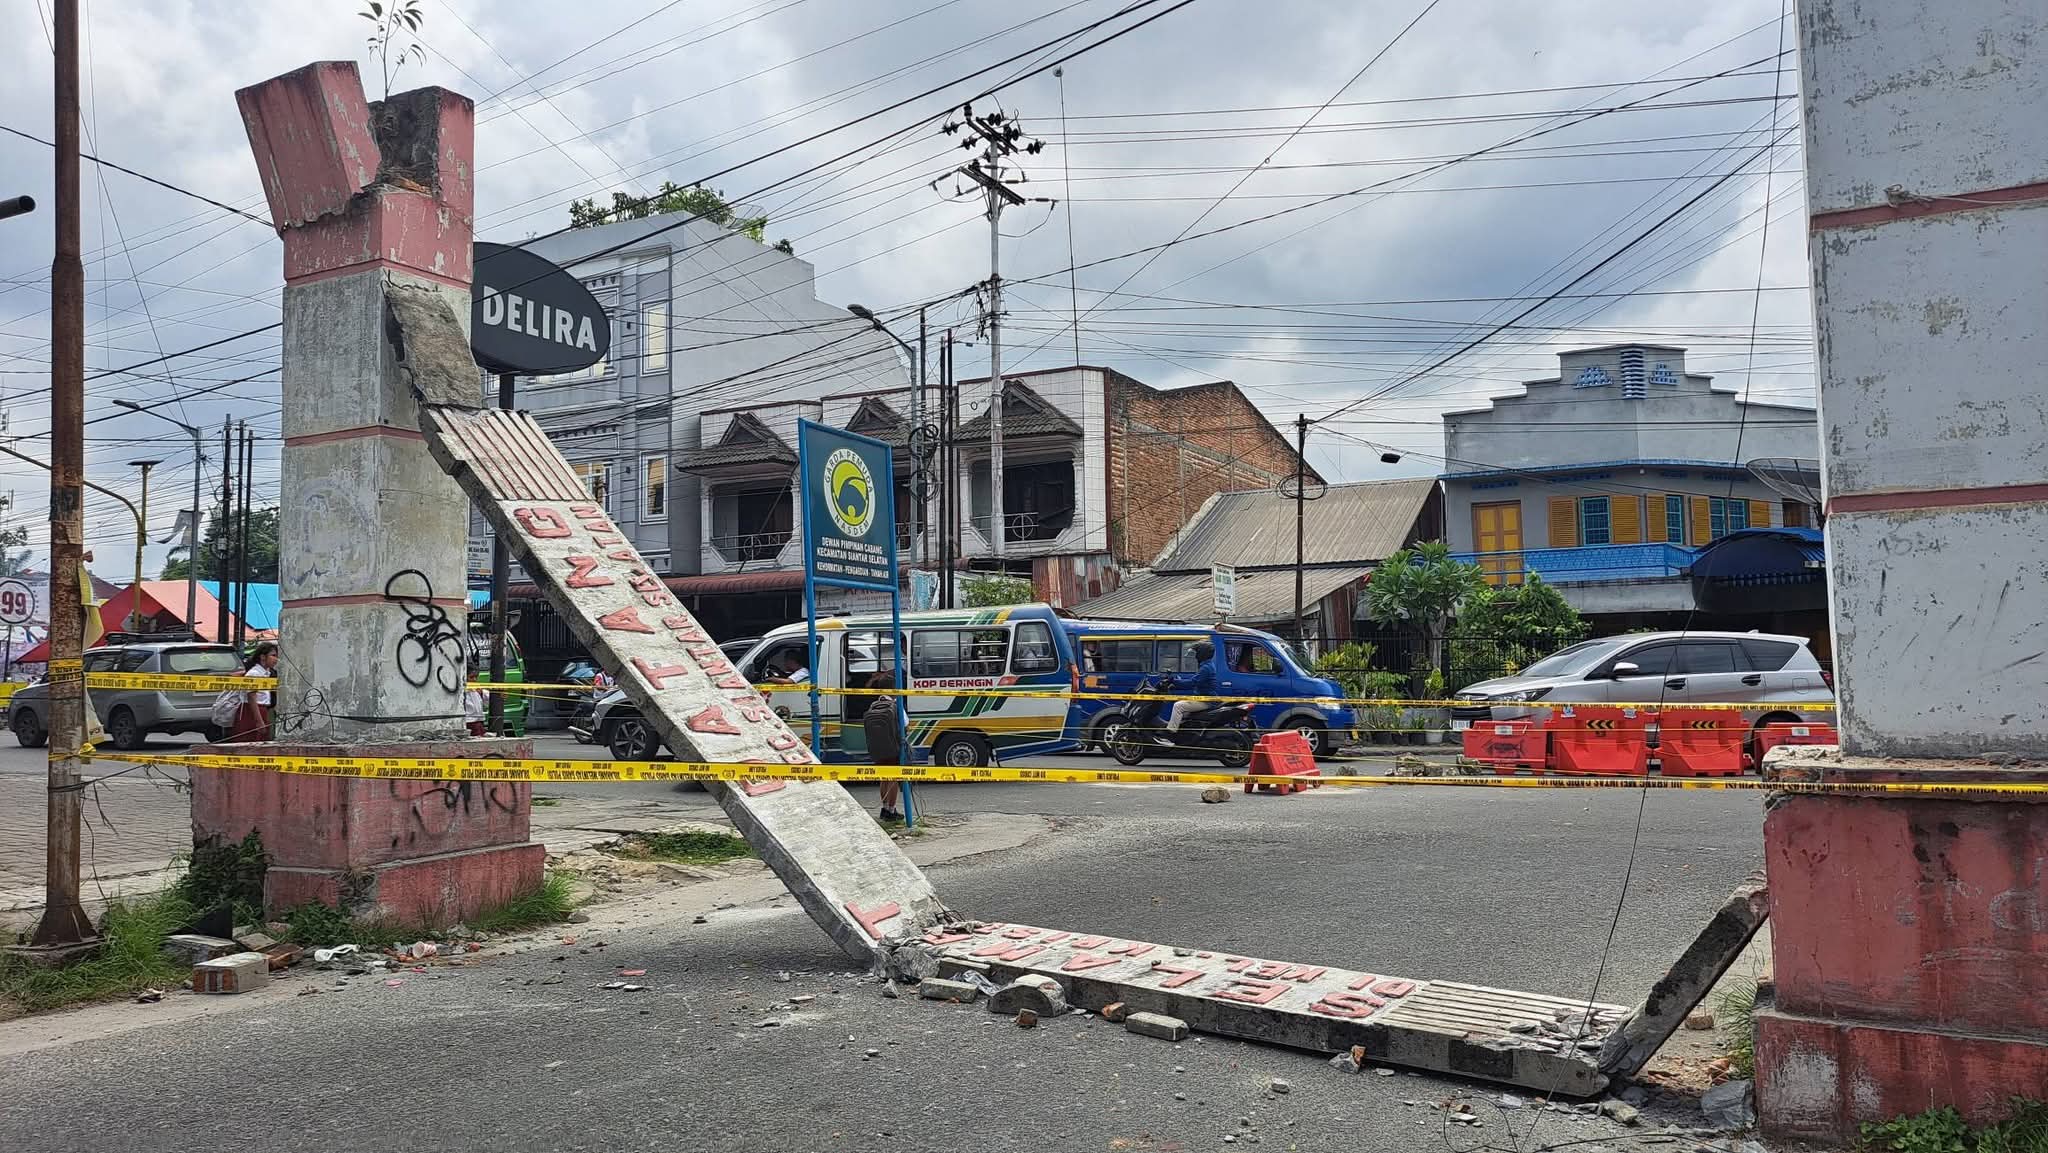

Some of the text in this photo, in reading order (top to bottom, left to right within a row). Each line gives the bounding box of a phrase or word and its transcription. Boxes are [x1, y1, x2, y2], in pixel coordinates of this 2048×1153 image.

[483, 286, 597, 352] DELIRA
[825, 451, 873, 492] GARDA PEMUDA
[834, 514, 869, 534] NASDEM
[817, 547, 888, 565] KECAMATAN SIANTAR SELATAN
[822, 537, 883, 555] DEWAN PIMPINAN CABANG
[2, 591, 27, 616] 99
[663, 613, 771, 723] SIANTAR
[913, 680, 937, 689] KOP
[1348, 975, 1416, 1000] DI
